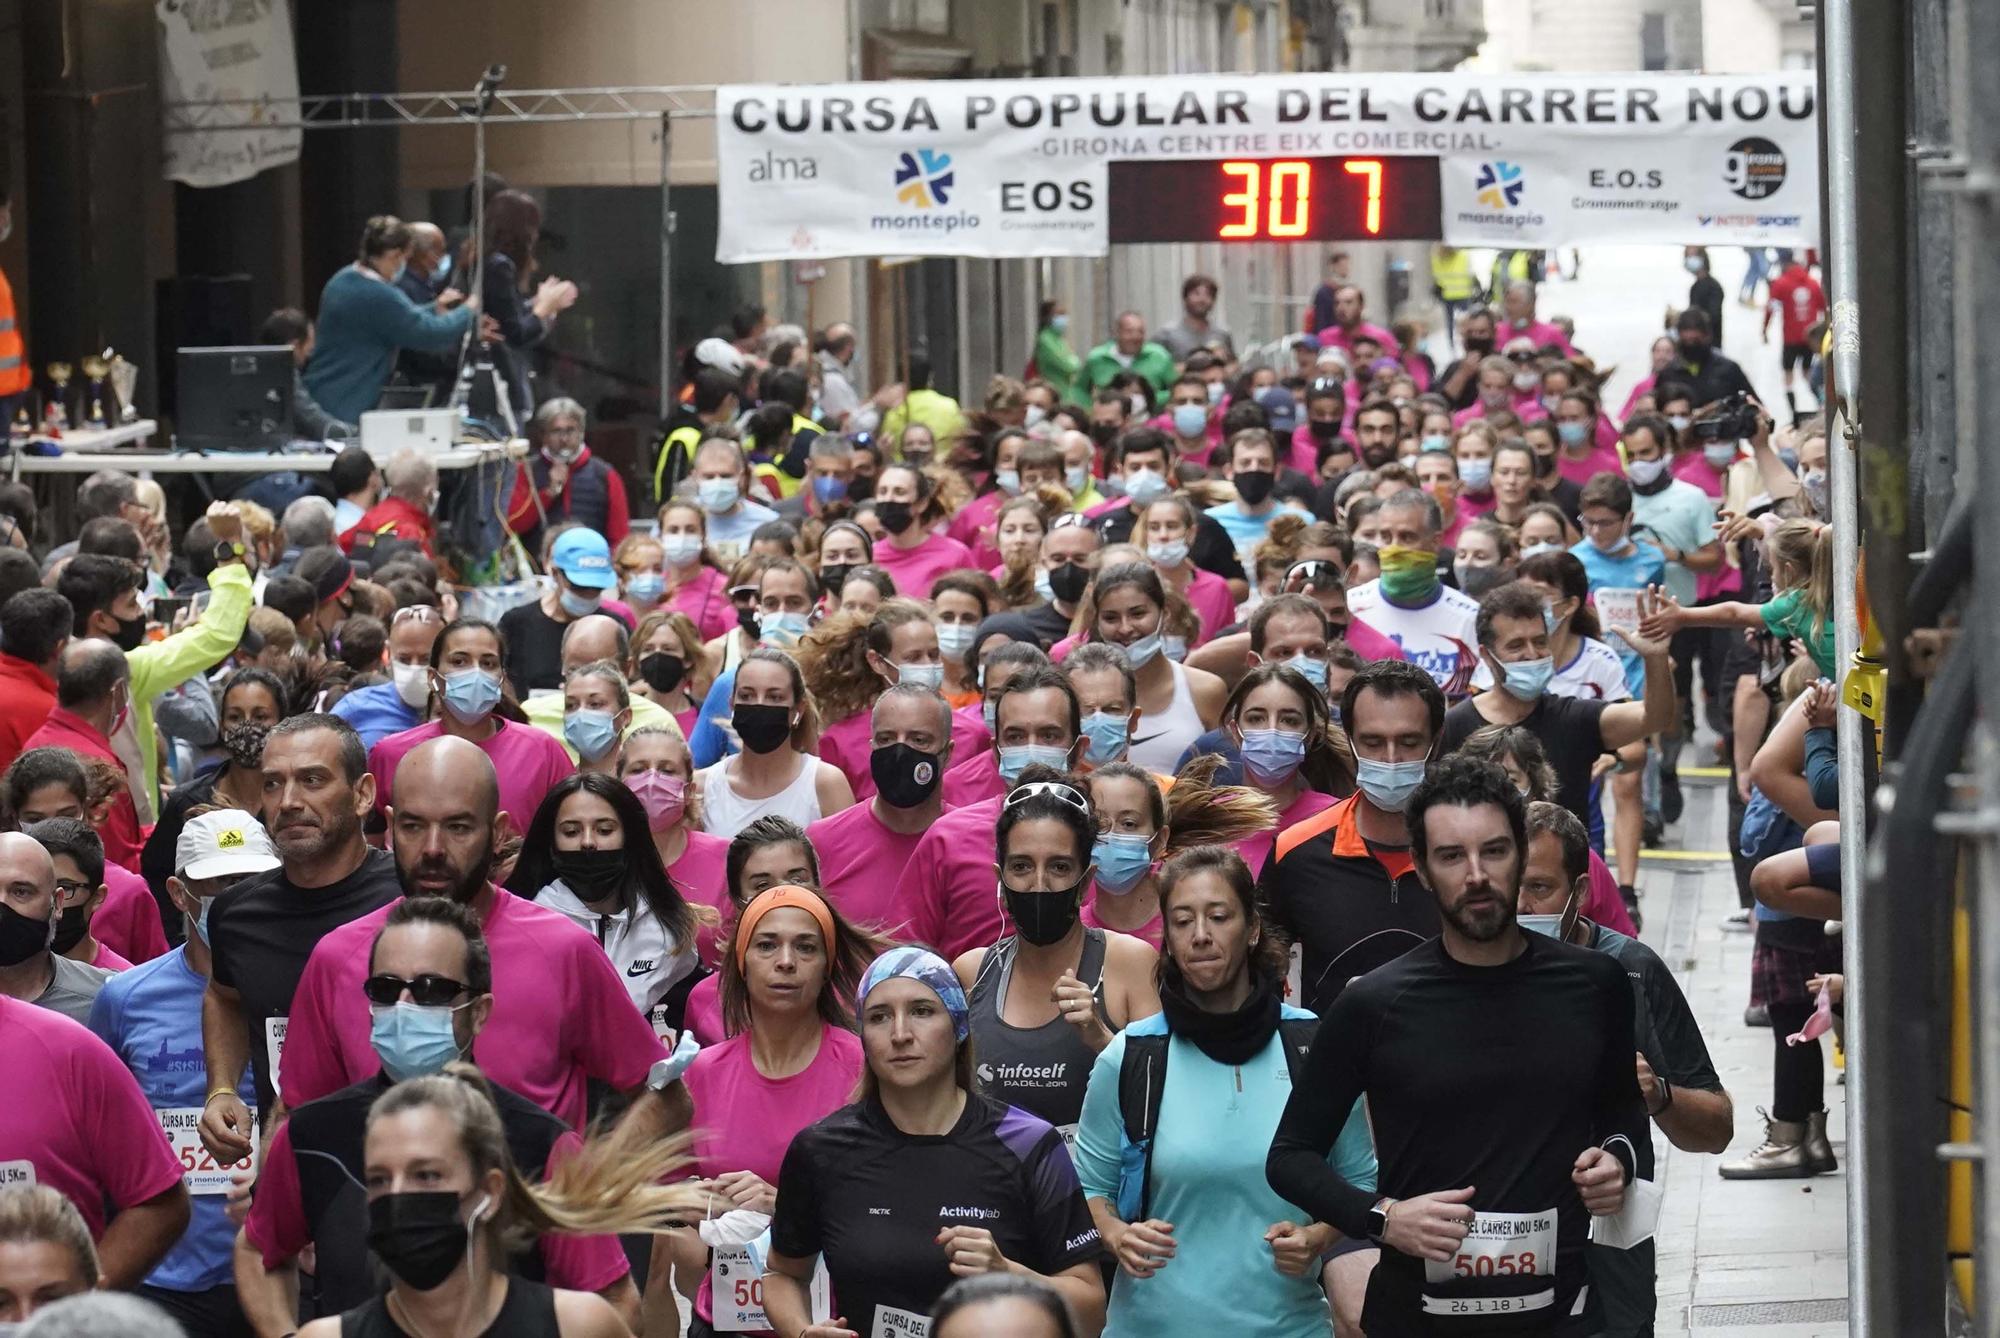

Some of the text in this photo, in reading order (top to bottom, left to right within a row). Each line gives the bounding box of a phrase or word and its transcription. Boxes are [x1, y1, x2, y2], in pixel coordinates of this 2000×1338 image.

[733, 86, 1814, 133] CURSA POPULAR DEL CARRER NOU
[1159, 134, 1266, 153] CENTRE
[1280, 133, 1321, 150] EIX
[749, 150, 817, 182] alma
[1589, 170, 1662, 188] E.O.S
[1001, 181, 1093, 212] EOS
[1219, 160, 1382, 237] 30 7
[871, 211, 980, 232] montepio
[632, 960, 654, 970] NIKE
[997, 1063, 1067, 1078] infoself
[162, 1115, 184, 1128] CURSA
[185, 1115, 198, 1127] DEL
[180, 1146, 252, 1171] 52
[939, 1206, 1000, 1219] Activitylab
[1513, 1220, 1531, 1235] NOU
[1533, 1219, 1550, 1232] 5Km
[1455, 1252, 1536, 1277] 5058
[735, 1280, 763, 1306] 50
[1452, 1301, 1468, 1312] 26
[882, 1311, 925, 1337] CURSA DEL
